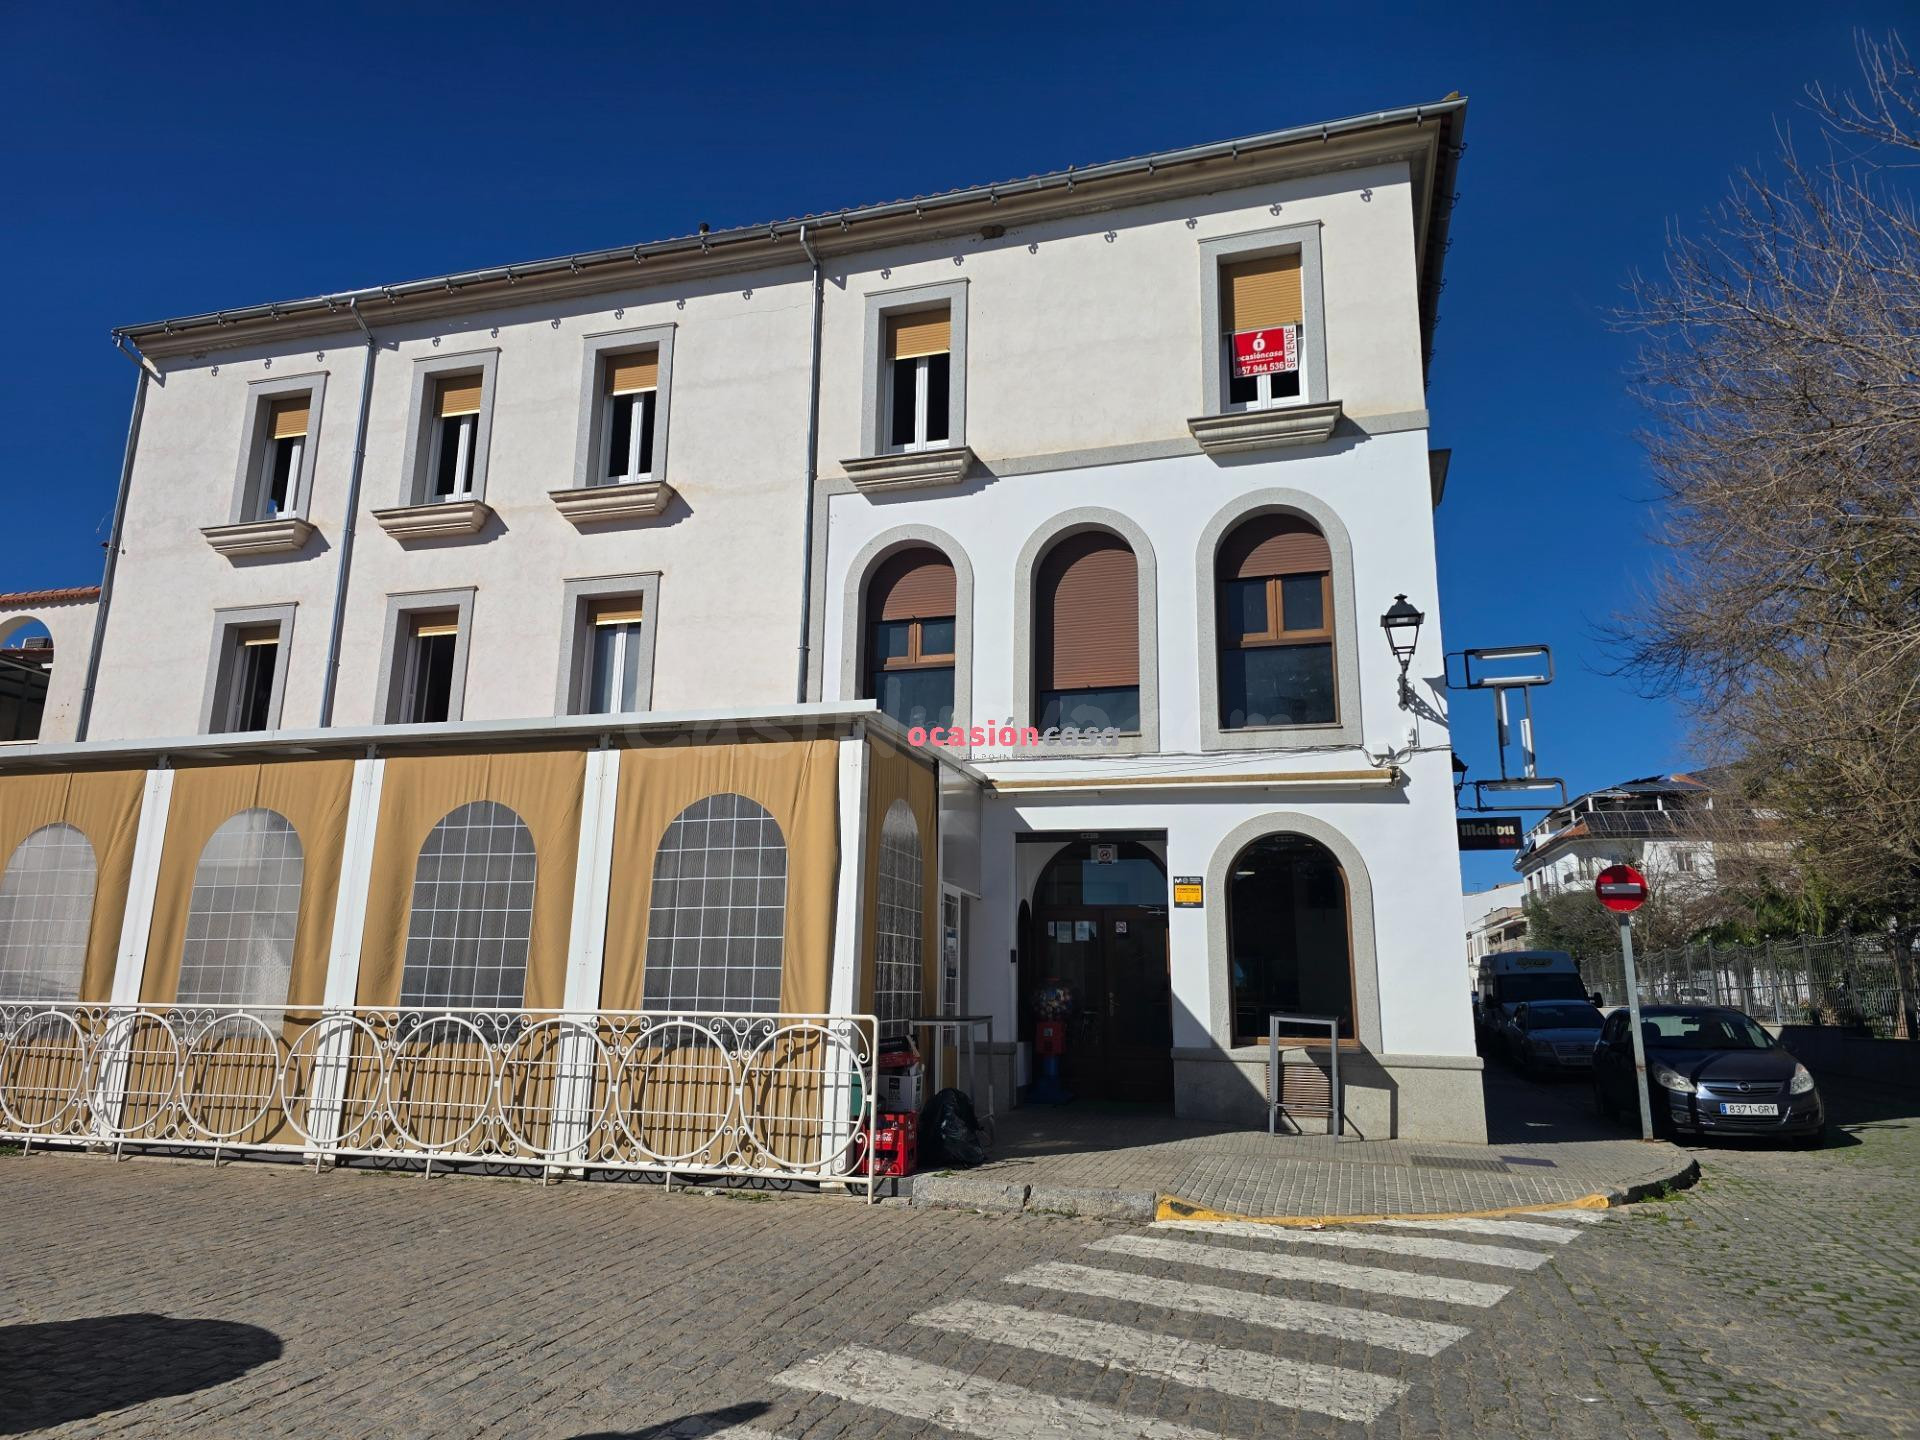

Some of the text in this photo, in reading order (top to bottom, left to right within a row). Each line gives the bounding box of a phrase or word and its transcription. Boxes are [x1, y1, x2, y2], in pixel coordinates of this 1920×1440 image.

[1286, 327, 1296, 368] SE VENDE
[1253, 363, 1267, 373] 944
[1460, 823, 1515, 836] Mahou
[1729, 1105, 1775, 1113] 8371 GRY
